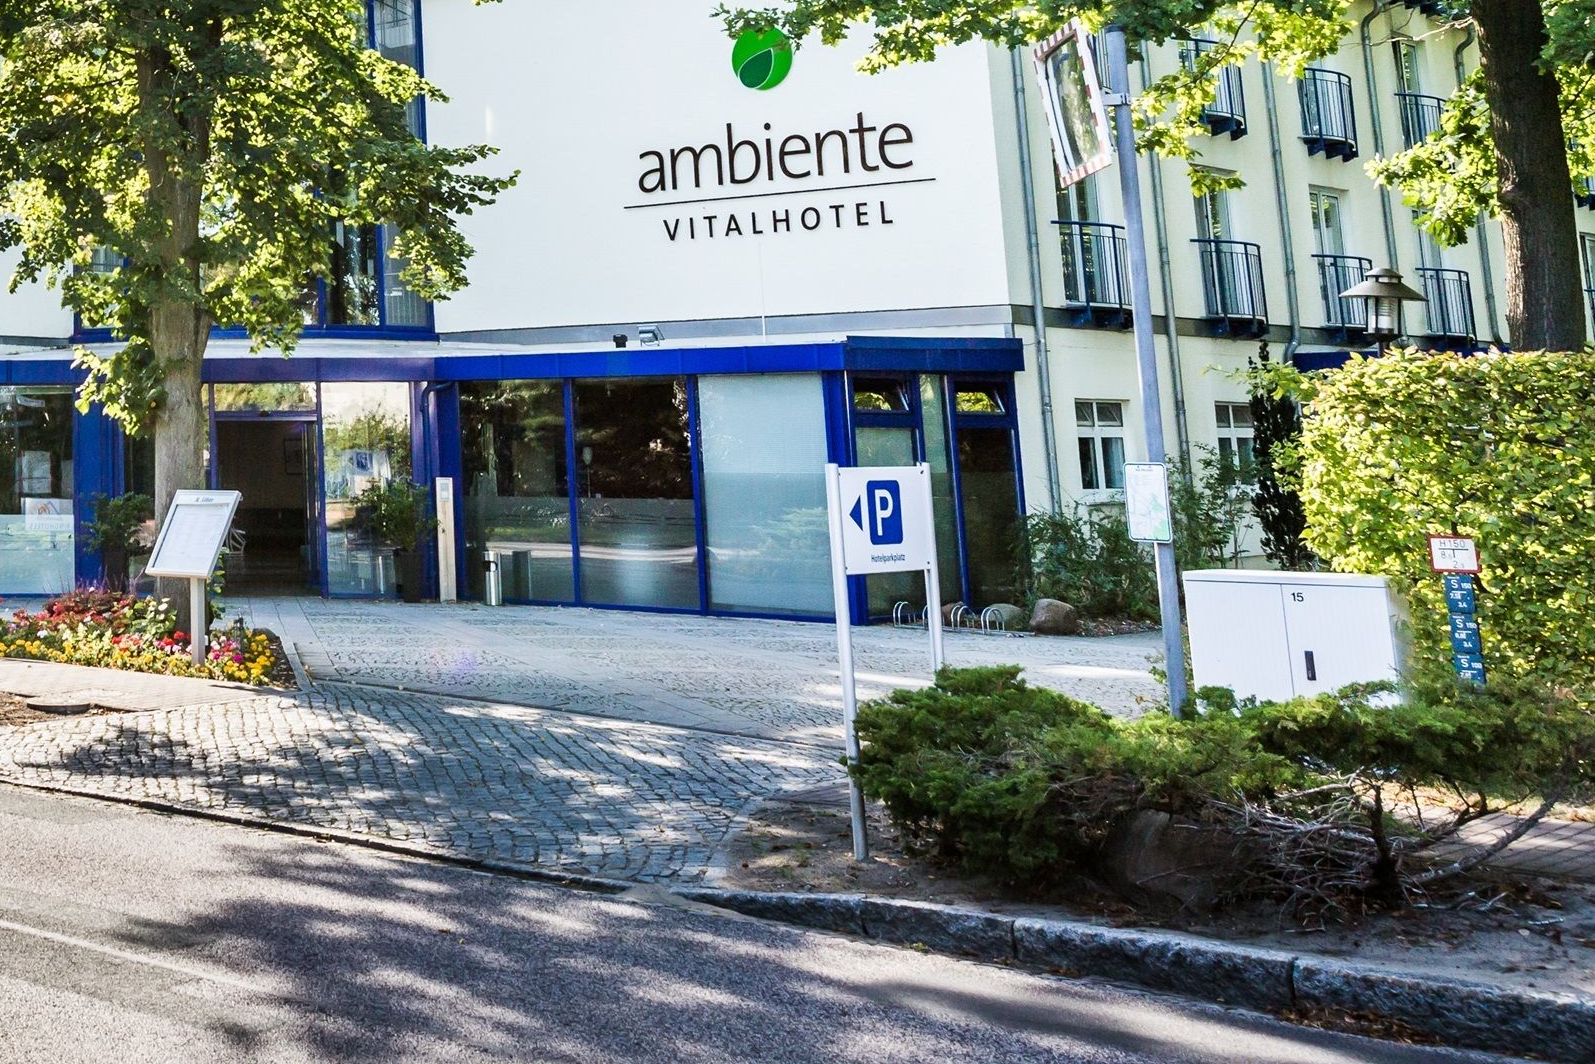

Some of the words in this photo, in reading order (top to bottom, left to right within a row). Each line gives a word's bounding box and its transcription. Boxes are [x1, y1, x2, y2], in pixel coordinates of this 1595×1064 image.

[638, 112, 914, 193] ambiente
[663, 201, 894, 241] VITALHOTEL
[874, 489, 894, 536] P
[871, 553, 906, 564] Hotelparkplatz
[1451, 579, 1458, 589] S
[1291, 592, 1304, 602] 15
[1456, 619, 1464, 628] S
[1460, 659, 1469, 668] S
